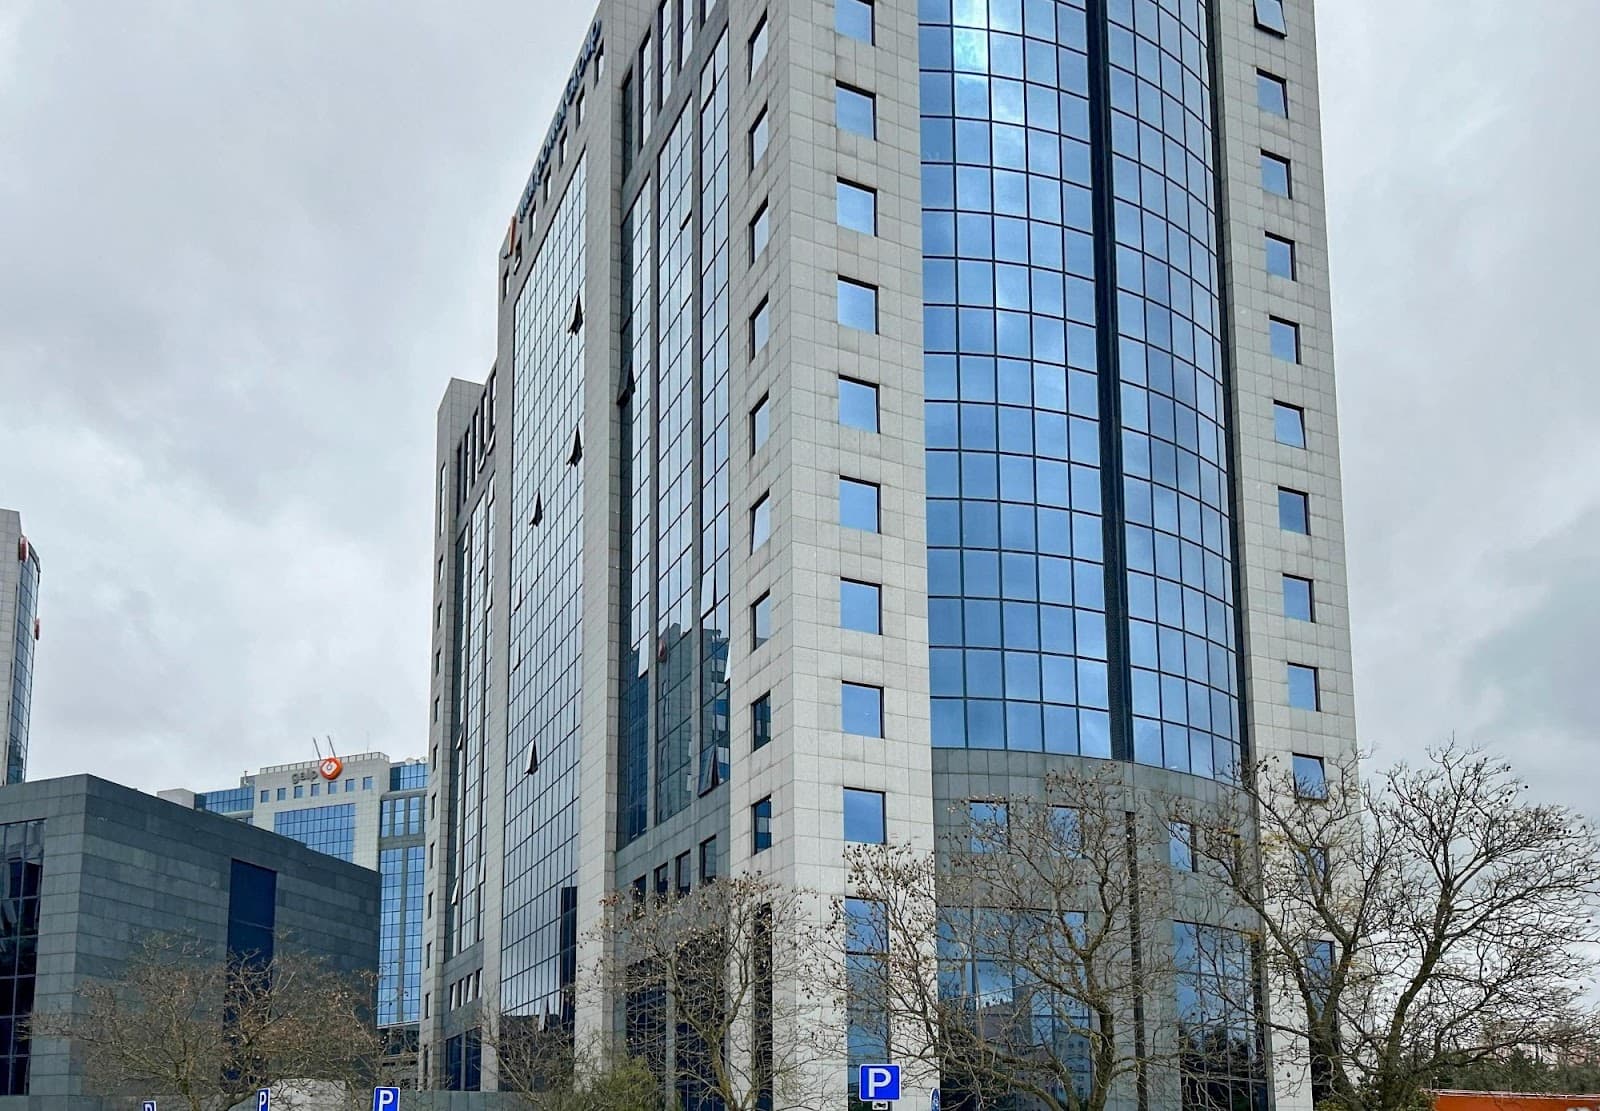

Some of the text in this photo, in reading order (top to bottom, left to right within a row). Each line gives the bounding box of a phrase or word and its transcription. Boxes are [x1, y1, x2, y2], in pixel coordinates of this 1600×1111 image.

[291, 768, 318, 785] galp
[868, 1067, 892, 1098] P
[258, 1091, 267, 1111] P
[379, 1090, 394, 1111] P
